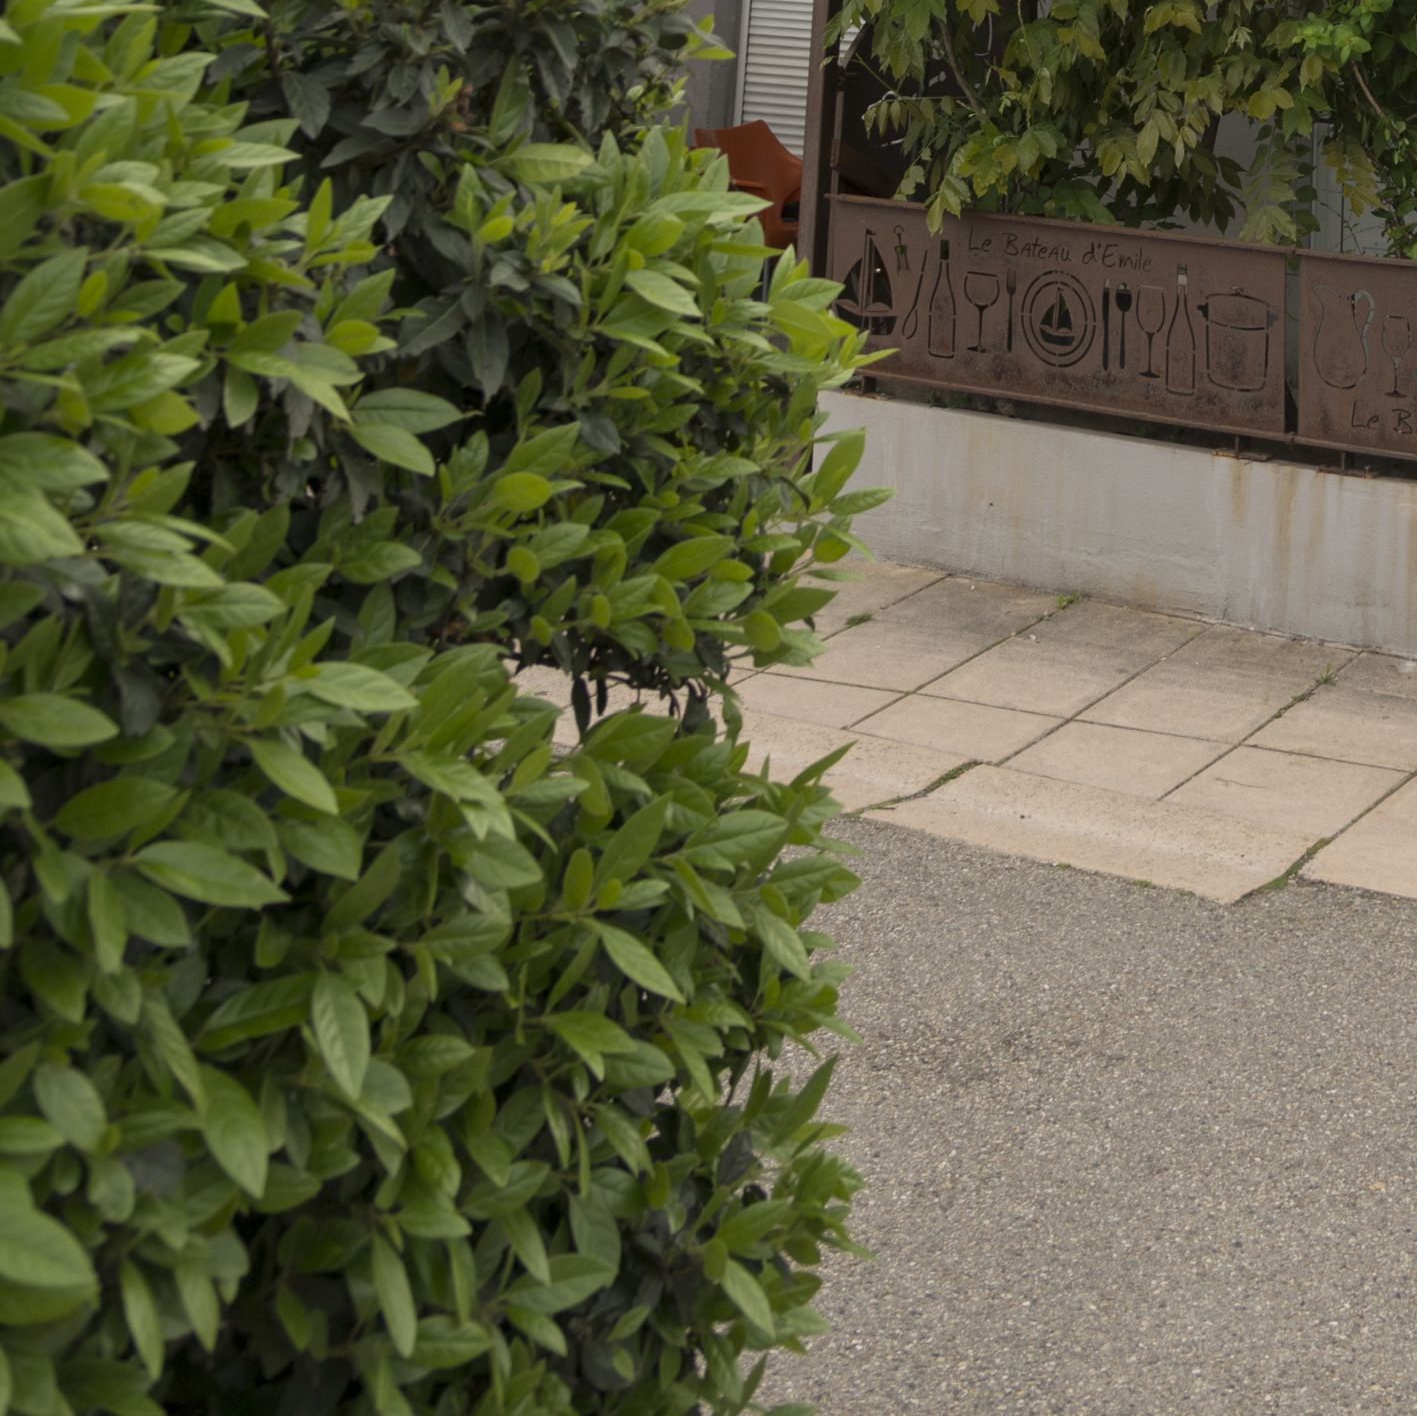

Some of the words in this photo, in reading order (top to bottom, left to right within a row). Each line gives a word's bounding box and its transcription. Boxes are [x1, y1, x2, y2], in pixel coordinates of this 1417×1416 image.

[968, 225, 993, 253] Le
[1082, 242, 1153, 273] d'Emile
[1351, 400, 1380, 430] Le
